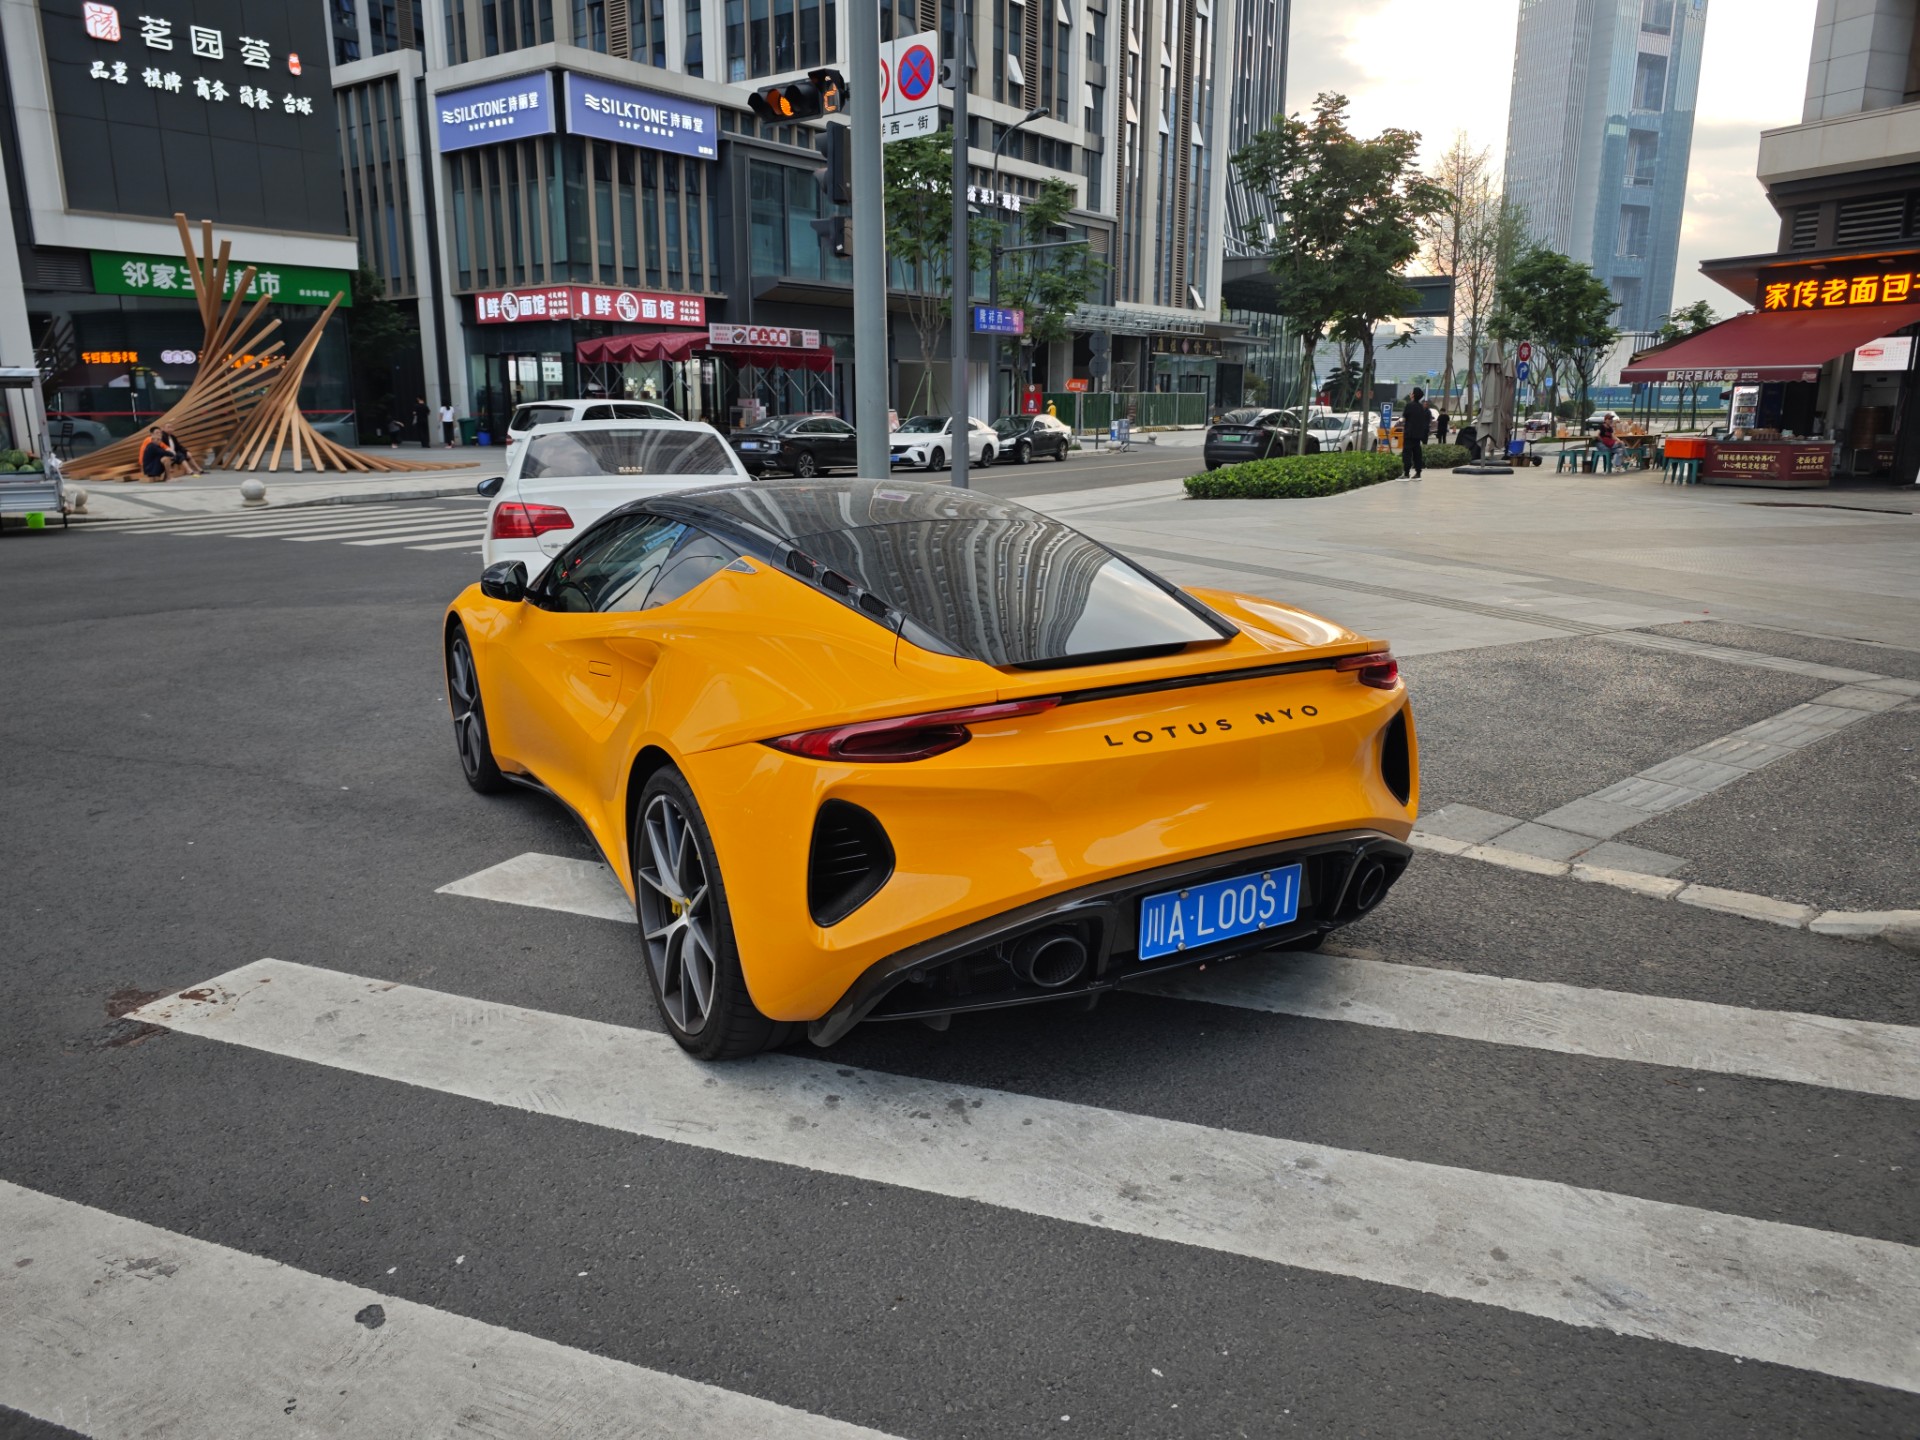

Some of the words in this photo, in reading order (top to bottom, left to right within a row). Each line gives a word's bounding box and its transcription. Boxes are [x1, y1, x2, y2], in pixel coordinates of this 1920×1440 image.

[138, 15, 271, 69] 茗园荟
[141, 67, 183, 94] 棋牌
[193, 76, 230, 101] 商务
[282, 92, 313, 116] 台球
[453, 97, 507, 124] SILKTONE
[601, 97, 669, 126] SILKTONE
[670, 111, 704, 133] 诗丽堂
[1103, 718, 1232, 747] LOTUS
[1254, 704, 1318, 725] NYO
